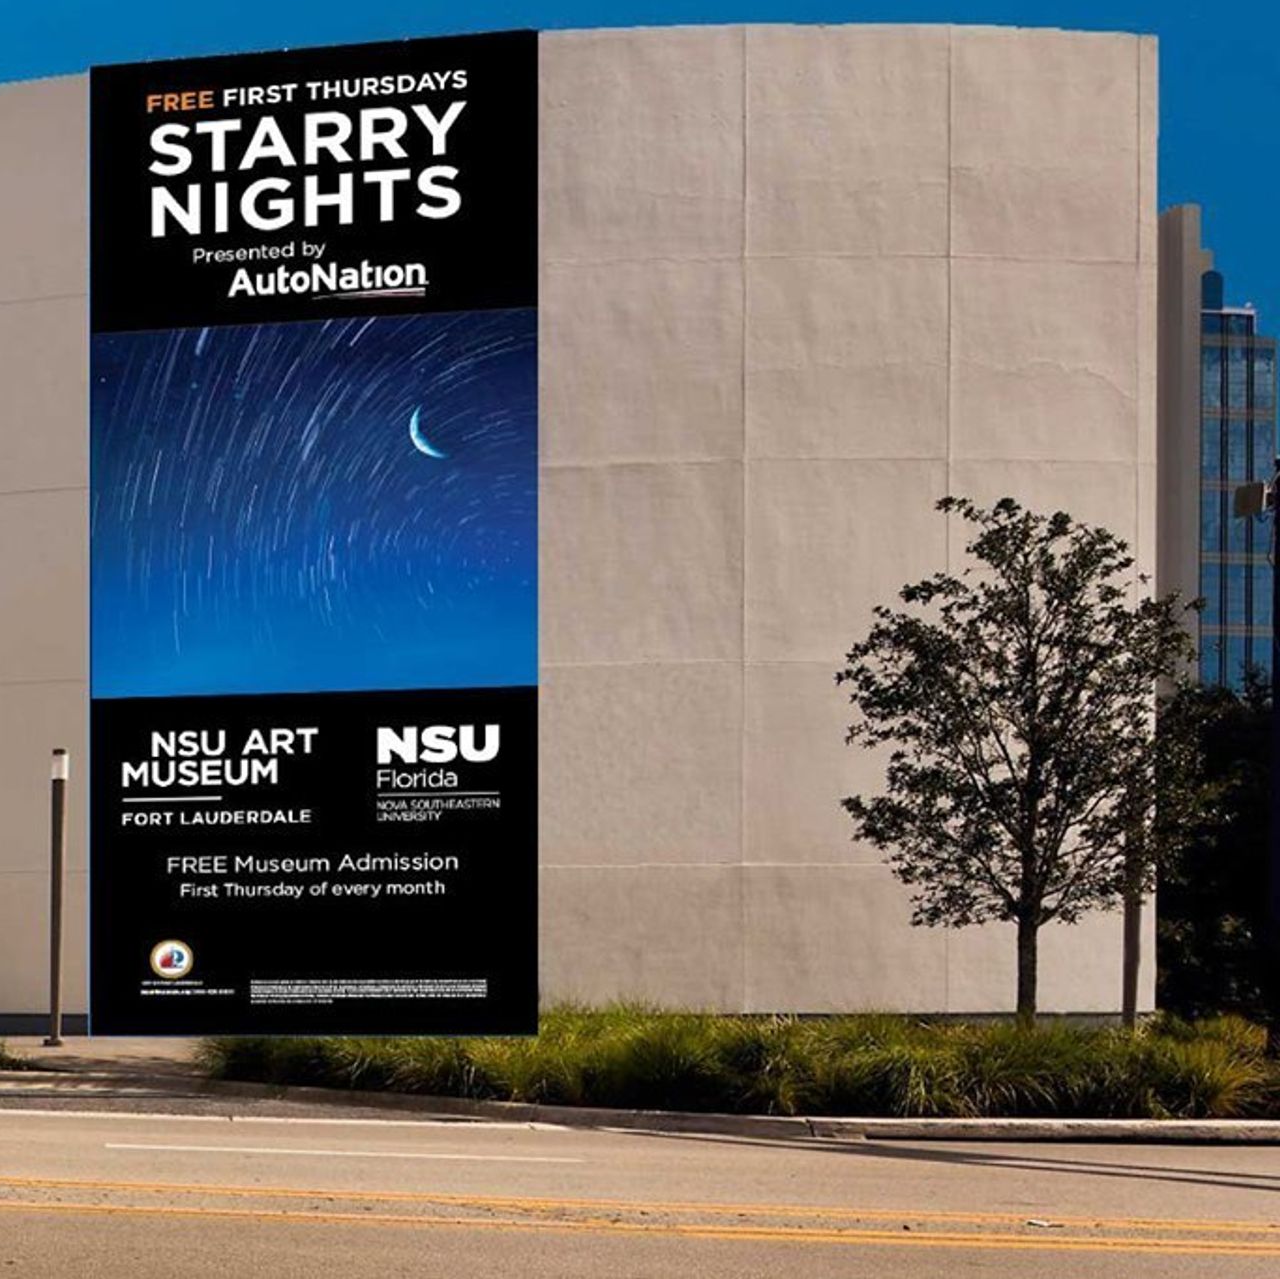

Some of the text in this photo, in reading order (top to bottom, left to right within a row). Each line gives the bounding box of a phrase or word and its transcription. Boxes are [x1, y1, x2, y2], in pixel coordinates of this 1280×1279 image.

[146, 70, 468, 113] FREE FIRST THURSDAYS
[149, 101, 468, 177] STARRY
[151, 165, 462, 238] NIGHTS
[193, 241, 326, 264] Presented by
[227, 261, 428, 299] AutoNation
[152, 728, 318, 757] NSU ART
[377, 725, 499, 764] NSU
[123, 759, 277, 787] MUSEUM
[377, 769, 457, 787] Florida
[376, 798, 500, 810] NOVA SOUTHEASTERN
[376, 811, 442, 821] UNIVERSITY
[122, 810, 310, 825] FORT LAUDERDALE
[168, 853, 458, 873] FREE Museum Admission
[181, 881, 445, 898] First Thursday of every month
